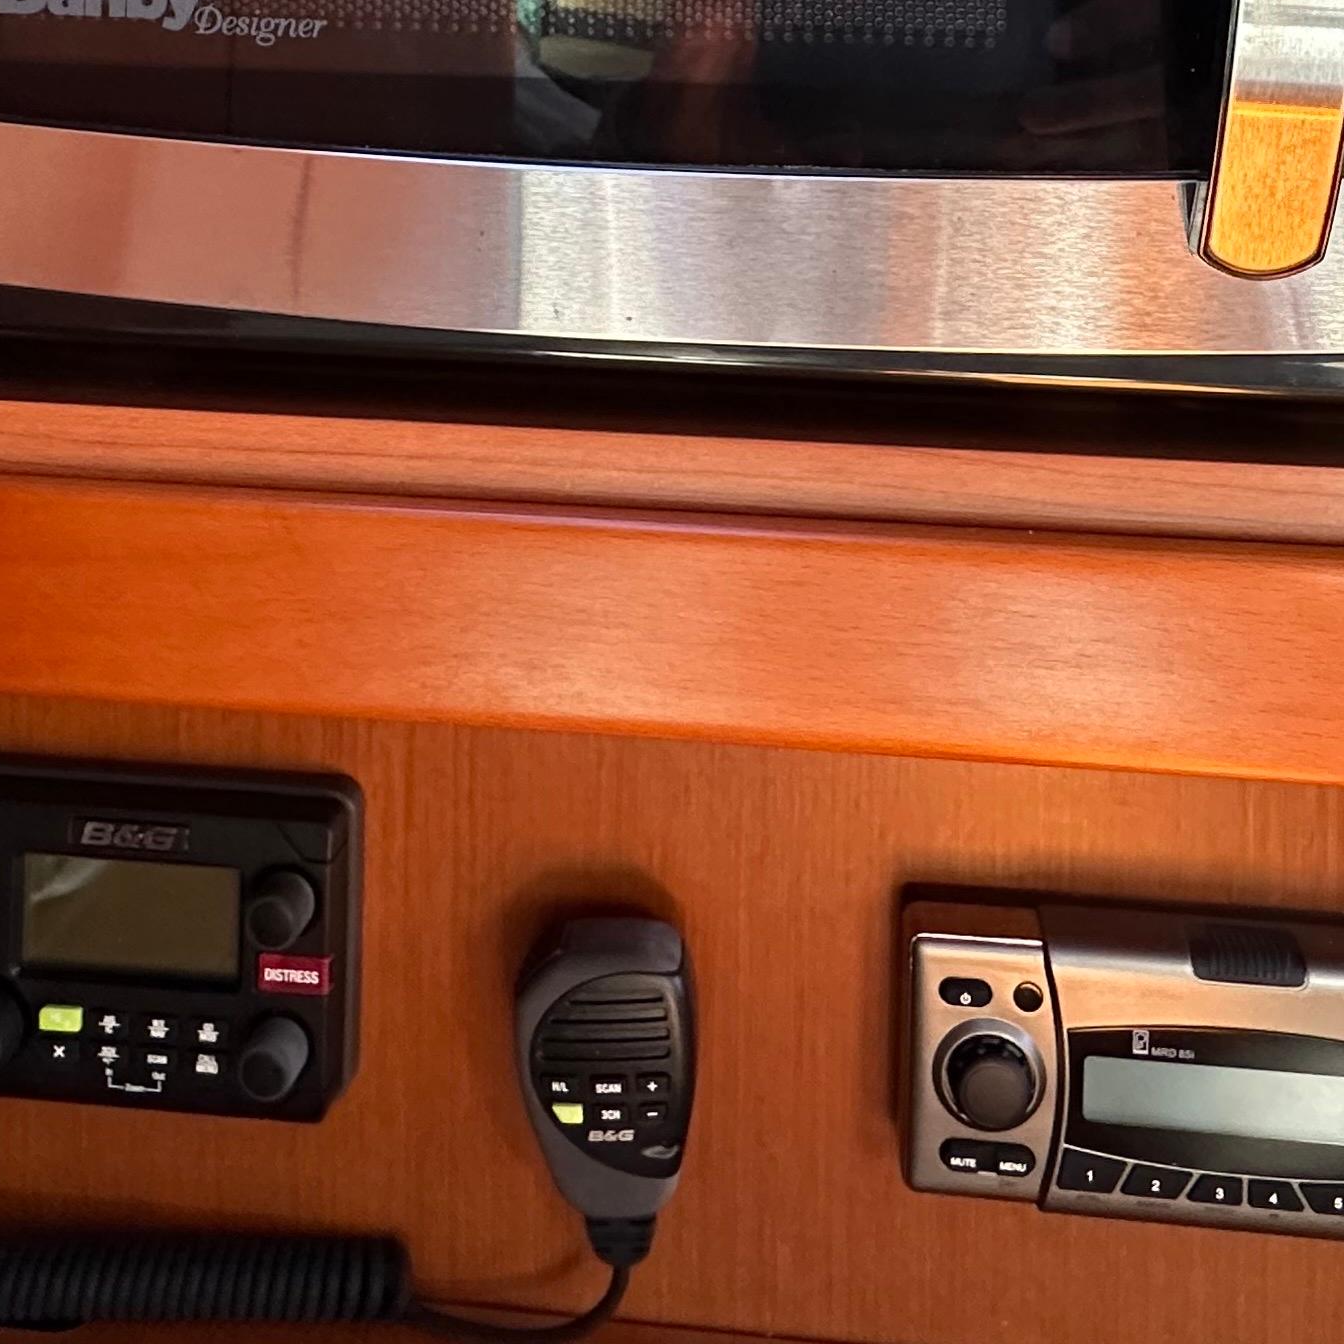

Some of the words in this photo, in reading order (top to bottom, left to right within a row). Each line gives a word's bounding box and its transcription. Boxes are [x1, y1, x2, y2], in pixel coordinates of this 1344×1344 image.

[194, 4, 329, 47] Designer
[80, 820, 178, 851] B&G
[263, 967, 320, 985] DISTRESS
[595, 1083, 622, 1093] SCAN
[587, 1129, 635, 1142] B&G
[950, 1156, 977, 1169] MUTE
[999, 1161, 1027, 1173] MENU
[1086, 1169, 1094, 1183] 1
[1151, 1179, 1161, 1192] 2
[1215, 1187, 1225, 1201] 3
[1268, 1192, 1278, 1205] 4
[1333, 1197, 1344, 1210] 5
